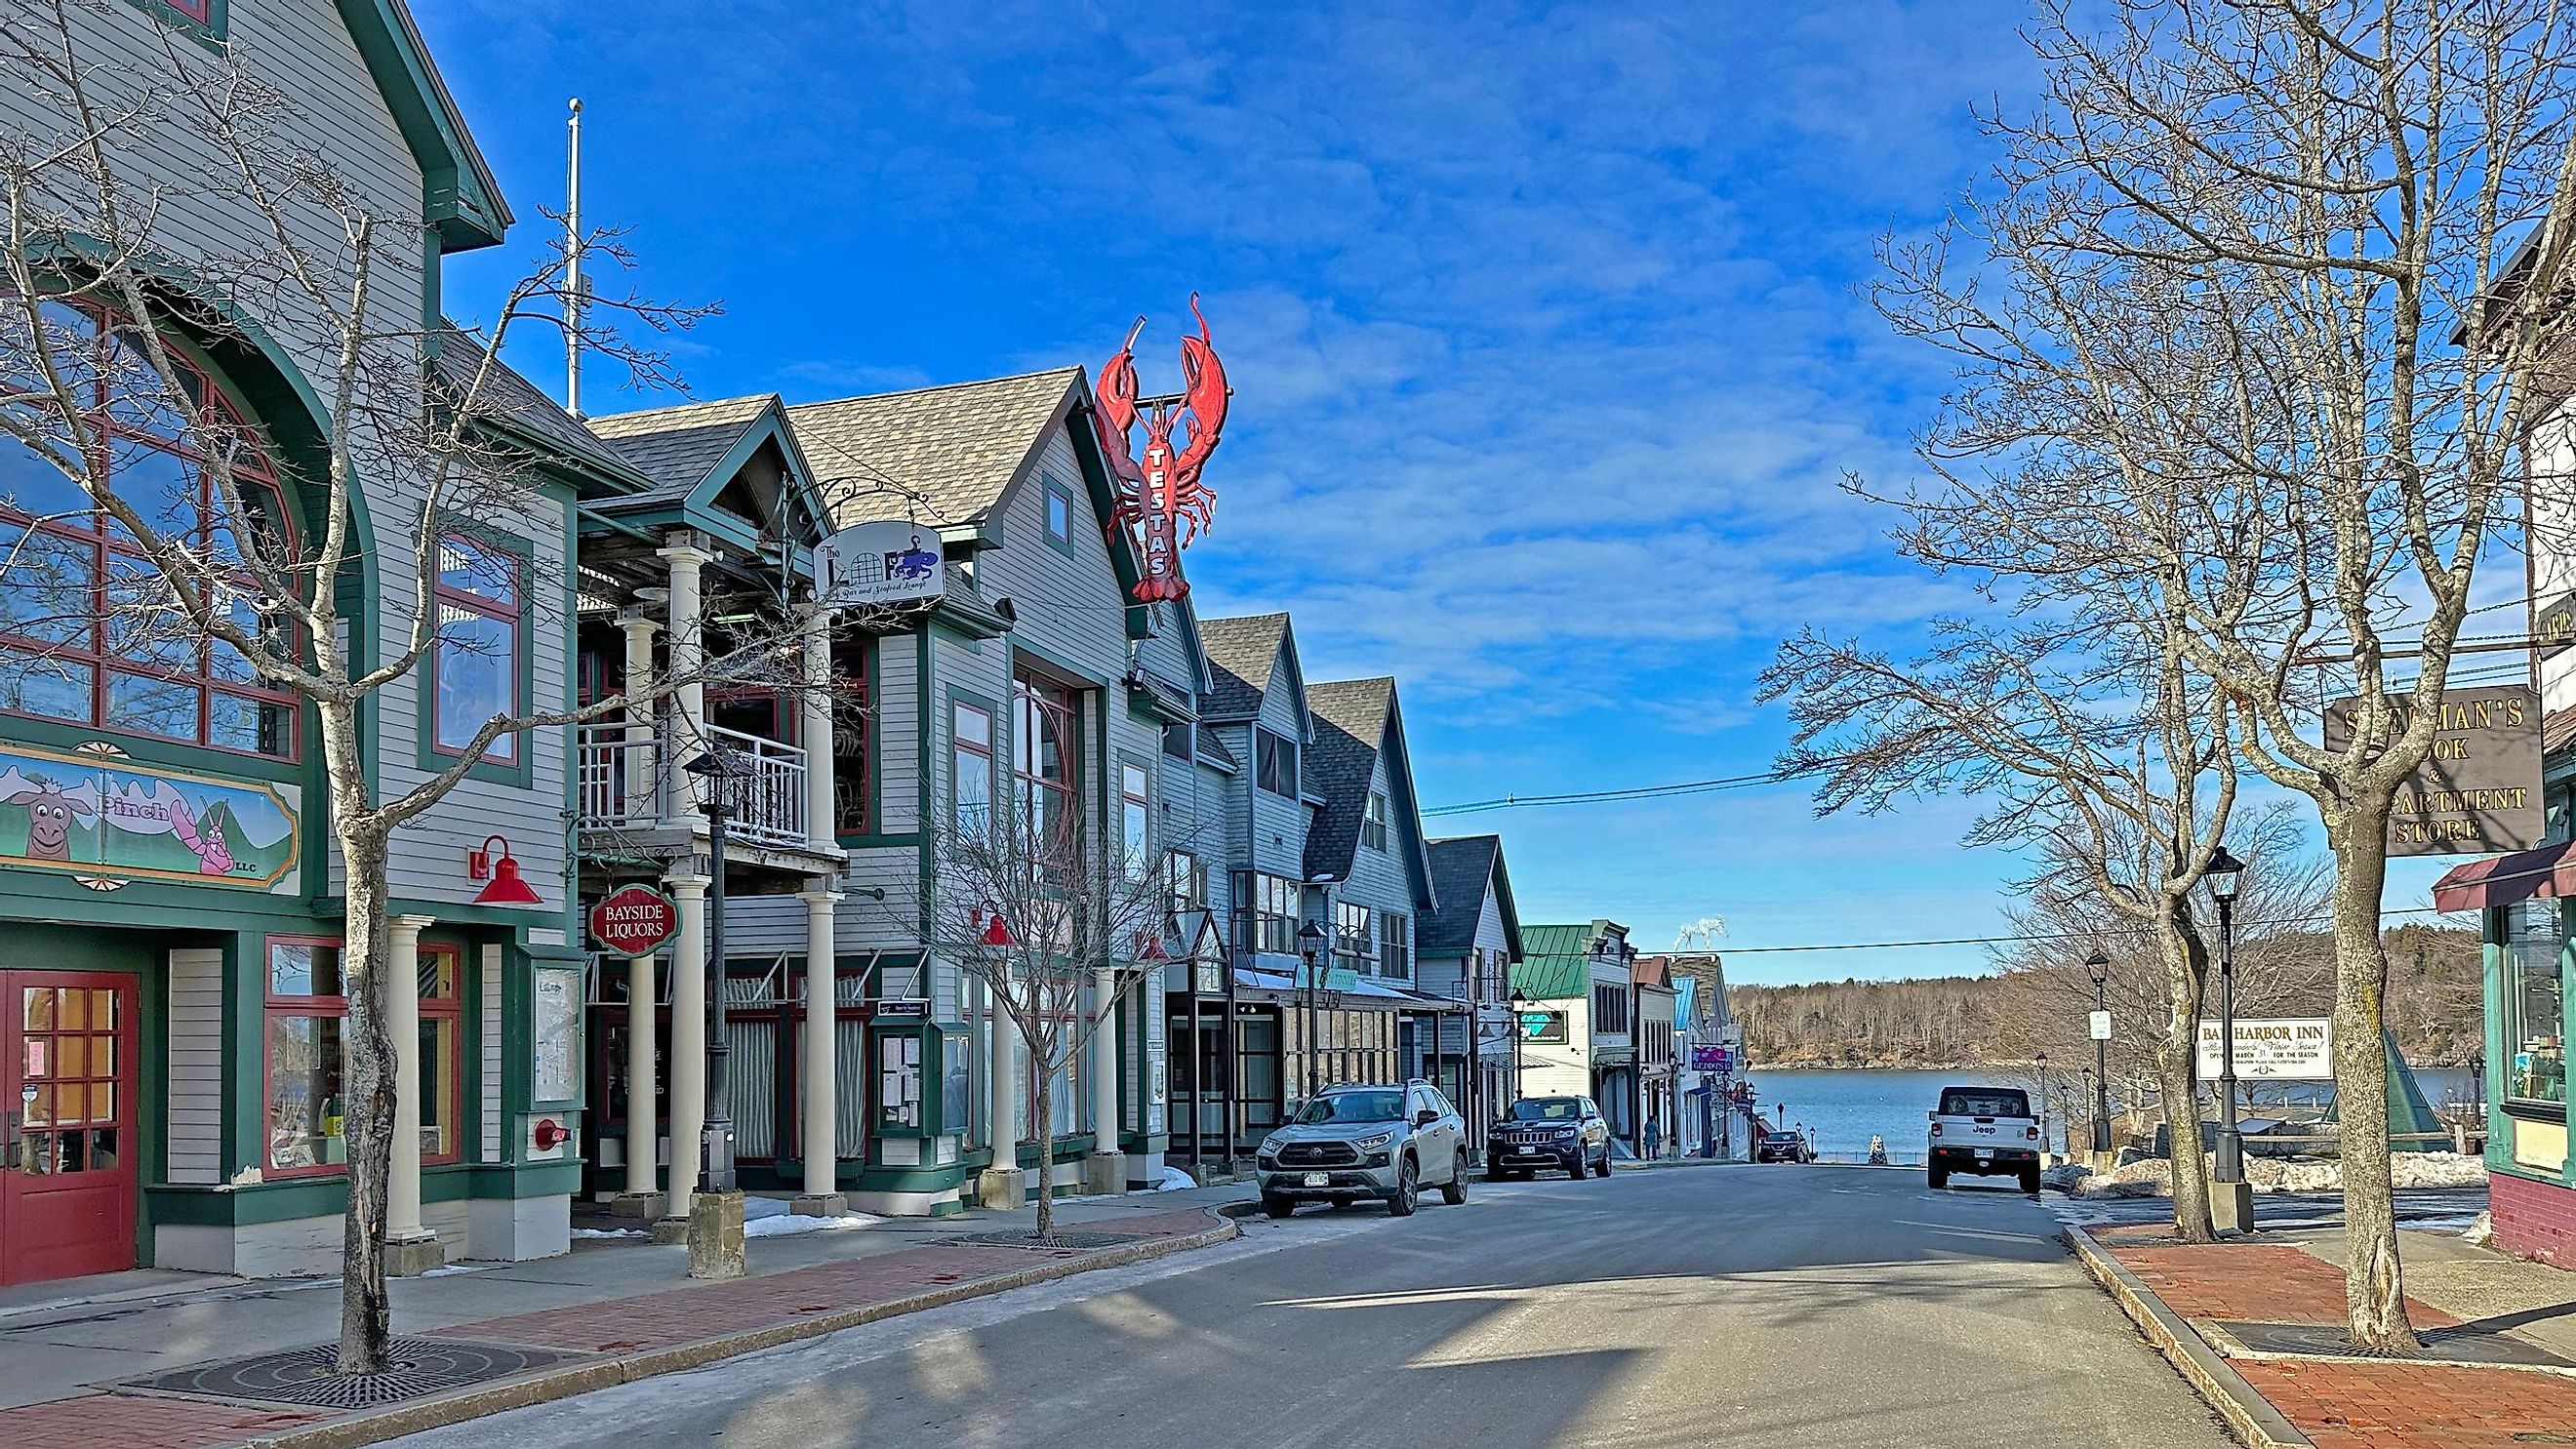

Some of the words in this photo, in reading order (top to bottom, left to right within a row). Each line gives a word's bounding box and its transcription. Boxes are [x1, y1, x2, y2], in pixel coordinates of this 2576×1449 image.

[2344, 698, 2524, 738] SEMAN'S
[2427, 768, 2442, 783] &
[96, 794, 170, 822] Pinch
[2390, 786, 2527, 816] PARTMENT
[2395, 818, 2480, 844] STORE
[235, 862, 257, 873] LLC
[606, 906, 664, 920] BAYSIDE
[605, 922, 664, 940] LIQUORS
[2202, 1027, 2224, 1040] BA
[2234, 1026, 2292, 1041] HARBOR
[2296, 1026, 2324, 1039] INN
[1972, 1125, 1996, 1136] Jeep
